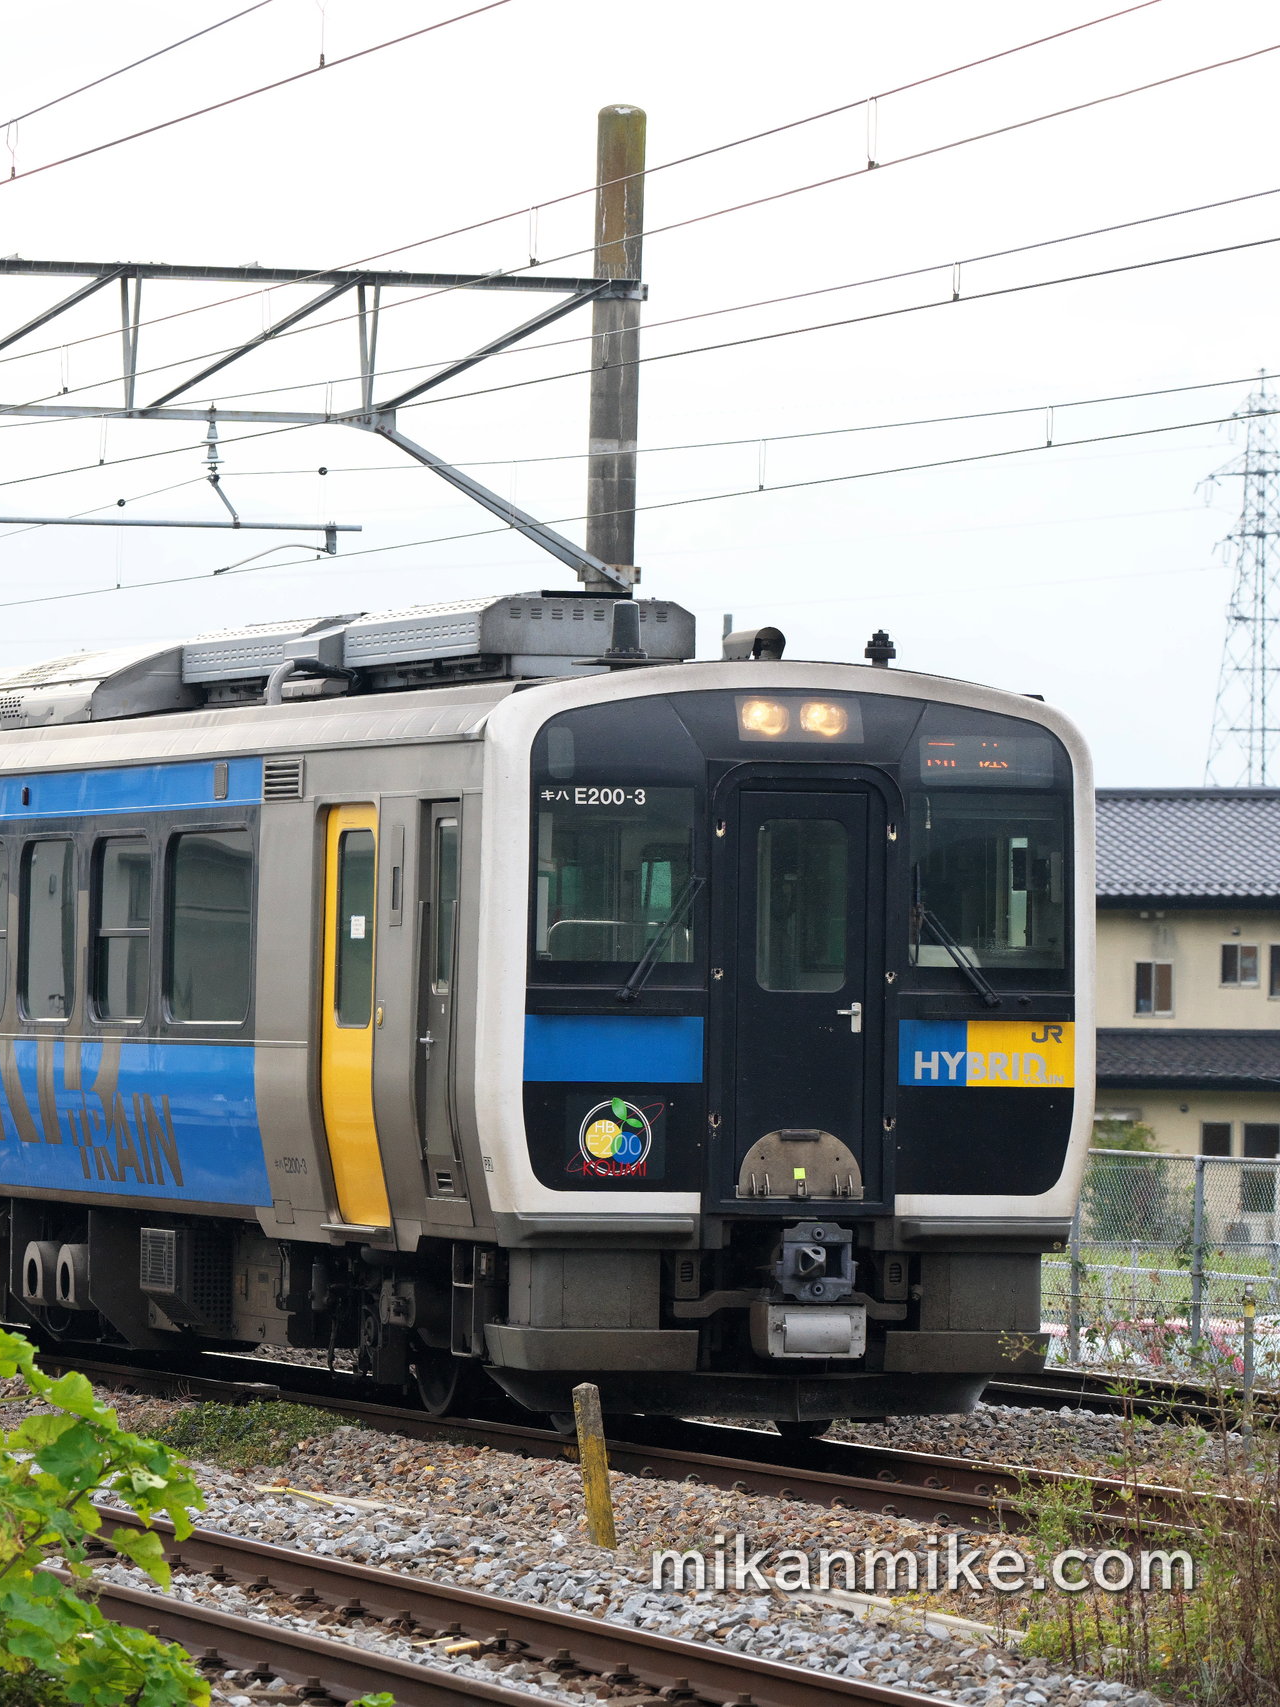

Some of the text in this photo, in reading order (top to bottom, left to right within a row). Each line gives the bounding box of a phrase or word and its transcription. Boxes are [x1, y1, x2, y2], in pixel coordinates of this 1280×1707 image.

[540, 787, 646, 805] キハ E200-3
[1031, 1024, 1063, 1044] JR
[914, 1051, 1047, 1081] HYBRID
[594, 1121, 615, 1133] HB
[587, 1134, 643, 1155] E200
[582, 1160, 647, 1176] KOUMI
